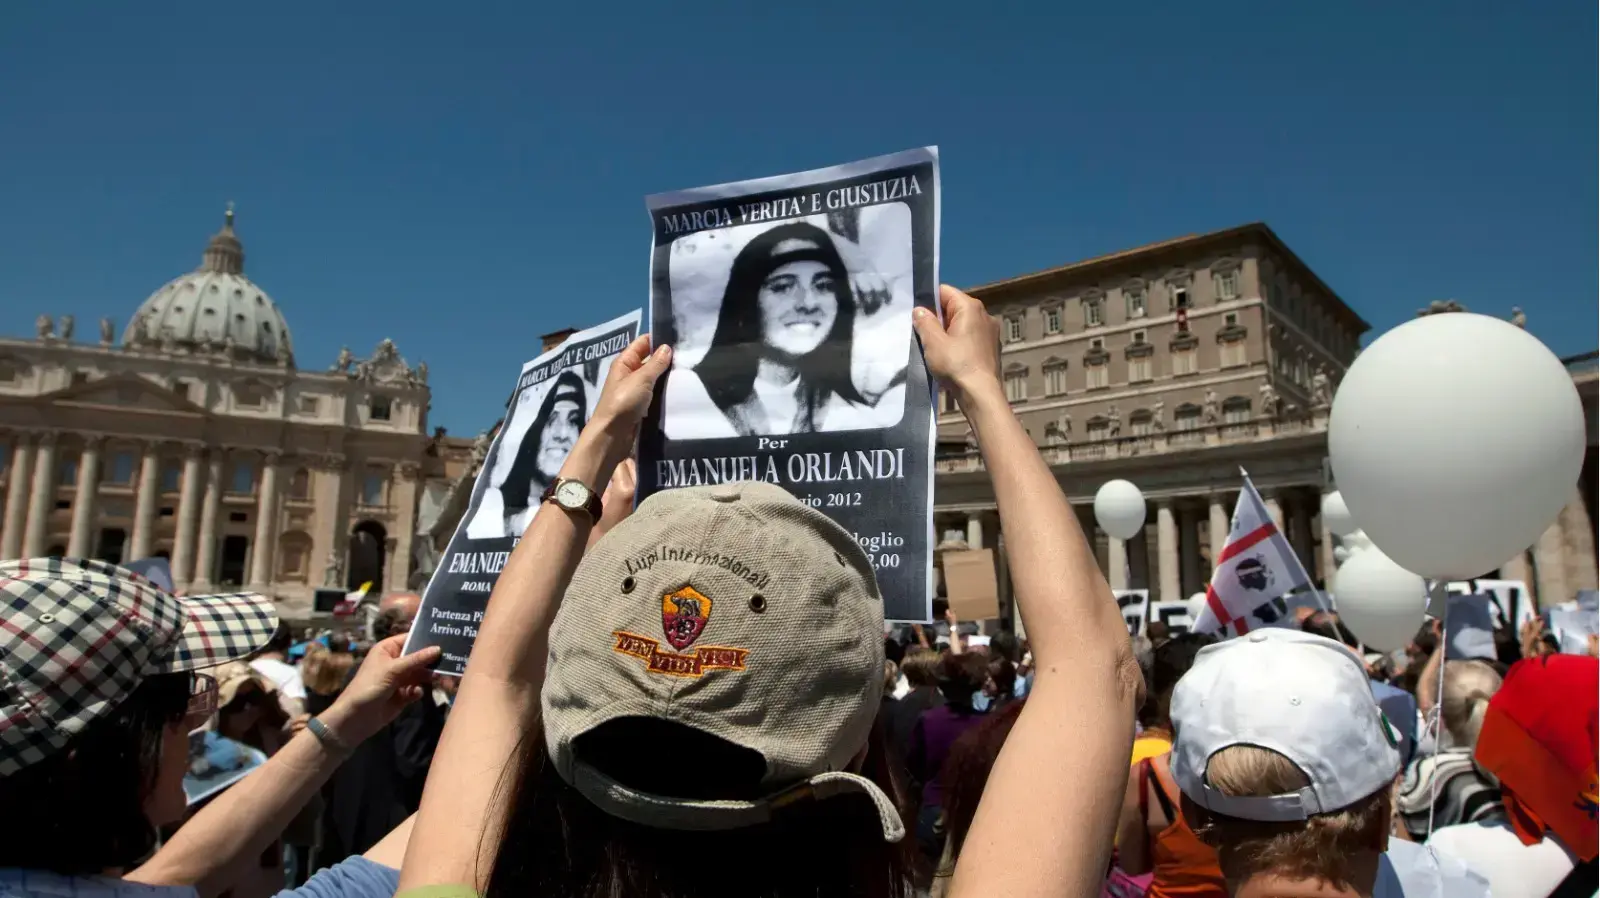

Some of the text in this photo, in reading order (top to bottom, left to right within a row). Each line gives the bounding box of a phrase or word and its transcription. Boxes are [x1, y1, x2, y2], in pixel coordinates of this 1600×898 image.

[664, 174, 922, 234] MARCIA VERITA' E GIUSTIZIA
[584, 331, 630, 361] GIUSTIZIA
[758, 437, 788, 450] Per
[656, 448, 905, 487] EMANUELA ORLANDI
[826, 492, 862, 507] 2012
[461, 581, 491, 592] ROMA
[431, 607, 471, 621] Partenza
[430, 622, 461, 635] Arrivo
